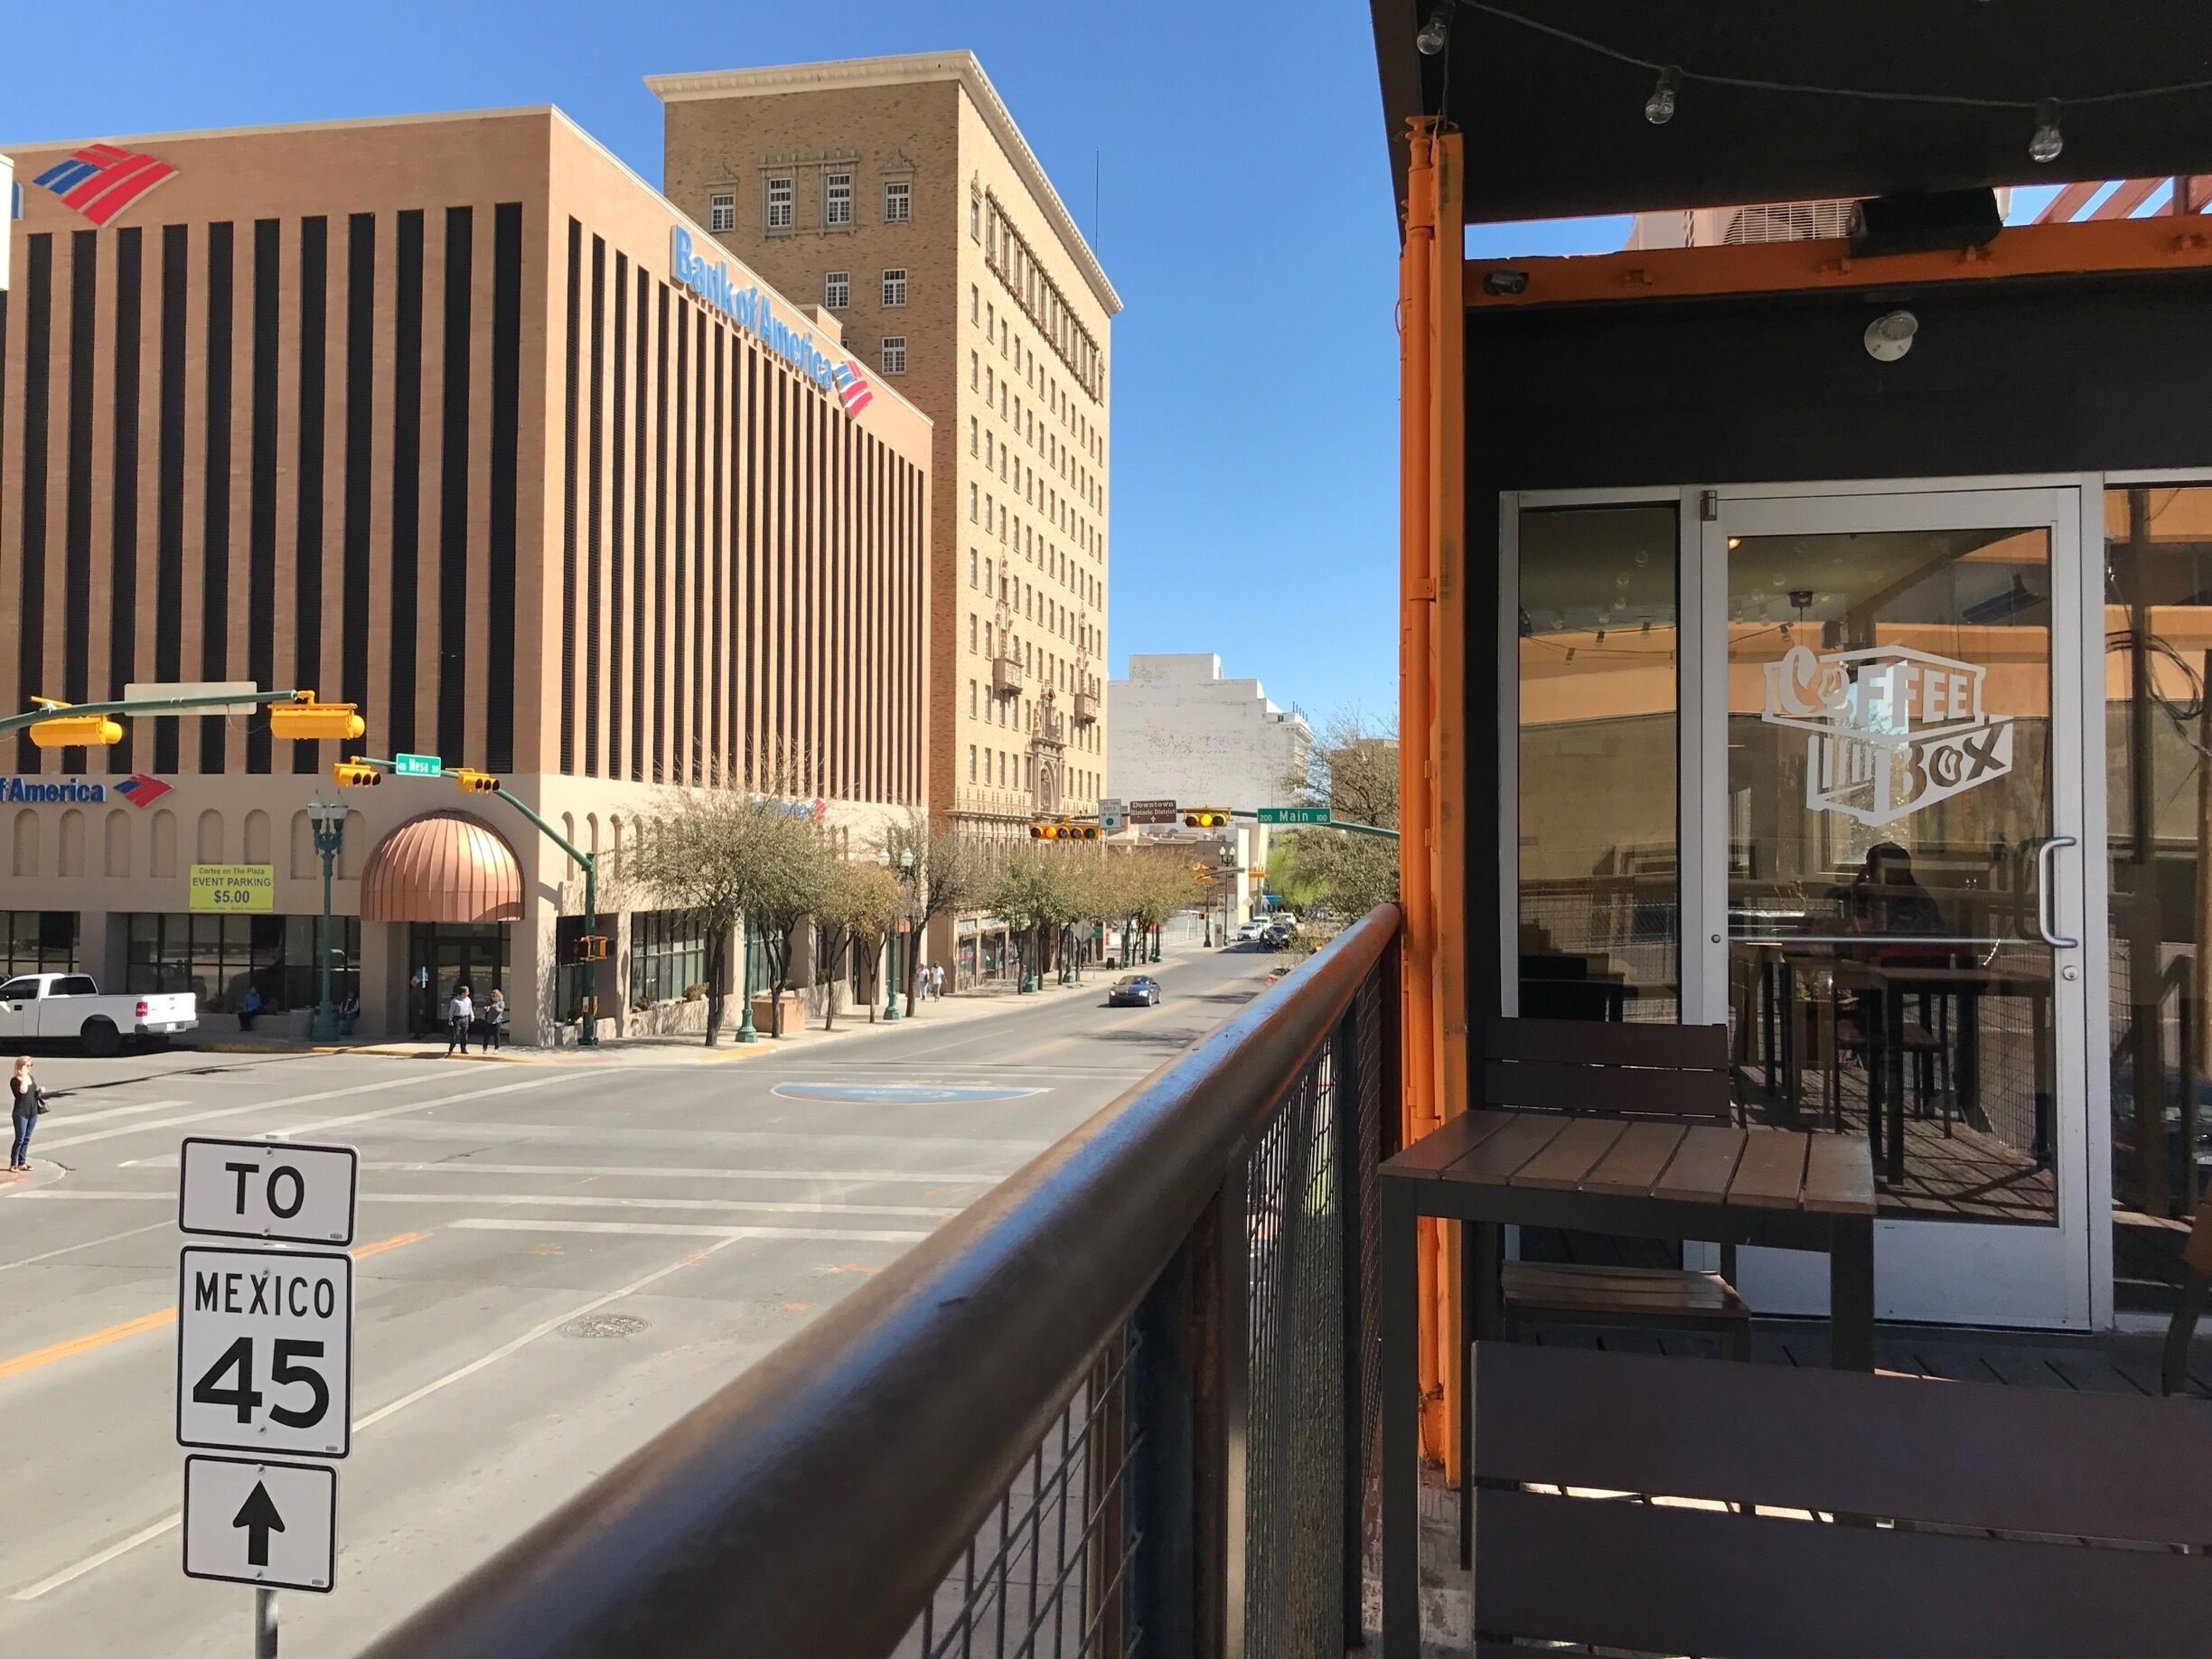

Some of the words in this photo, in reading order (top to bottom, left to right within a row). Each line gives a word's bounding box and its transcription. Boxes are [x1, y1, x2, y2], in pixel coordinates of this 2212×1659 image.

[671, 224, 733, 320] Bank
[733, 286, 758, 333] of
[757, 295, 833, 391] America
[409, 758, 429, 773] Mesa
[1890, 723, 2007, 810] BOX
[0, 777, 9, 802] f
[8, 777, 106, 802] America
[1279, 810, 1308, 821] Main
[192, 877, 225, 886] EVENT
[228, 877, 271, 886] PARKING
[214, 890, 249, 904] $5.00
[225, 1162, 305, 1219] TO
[194, 1270, 335, 1319] MEXICO
[192, 1336, 330, 1429] 45
